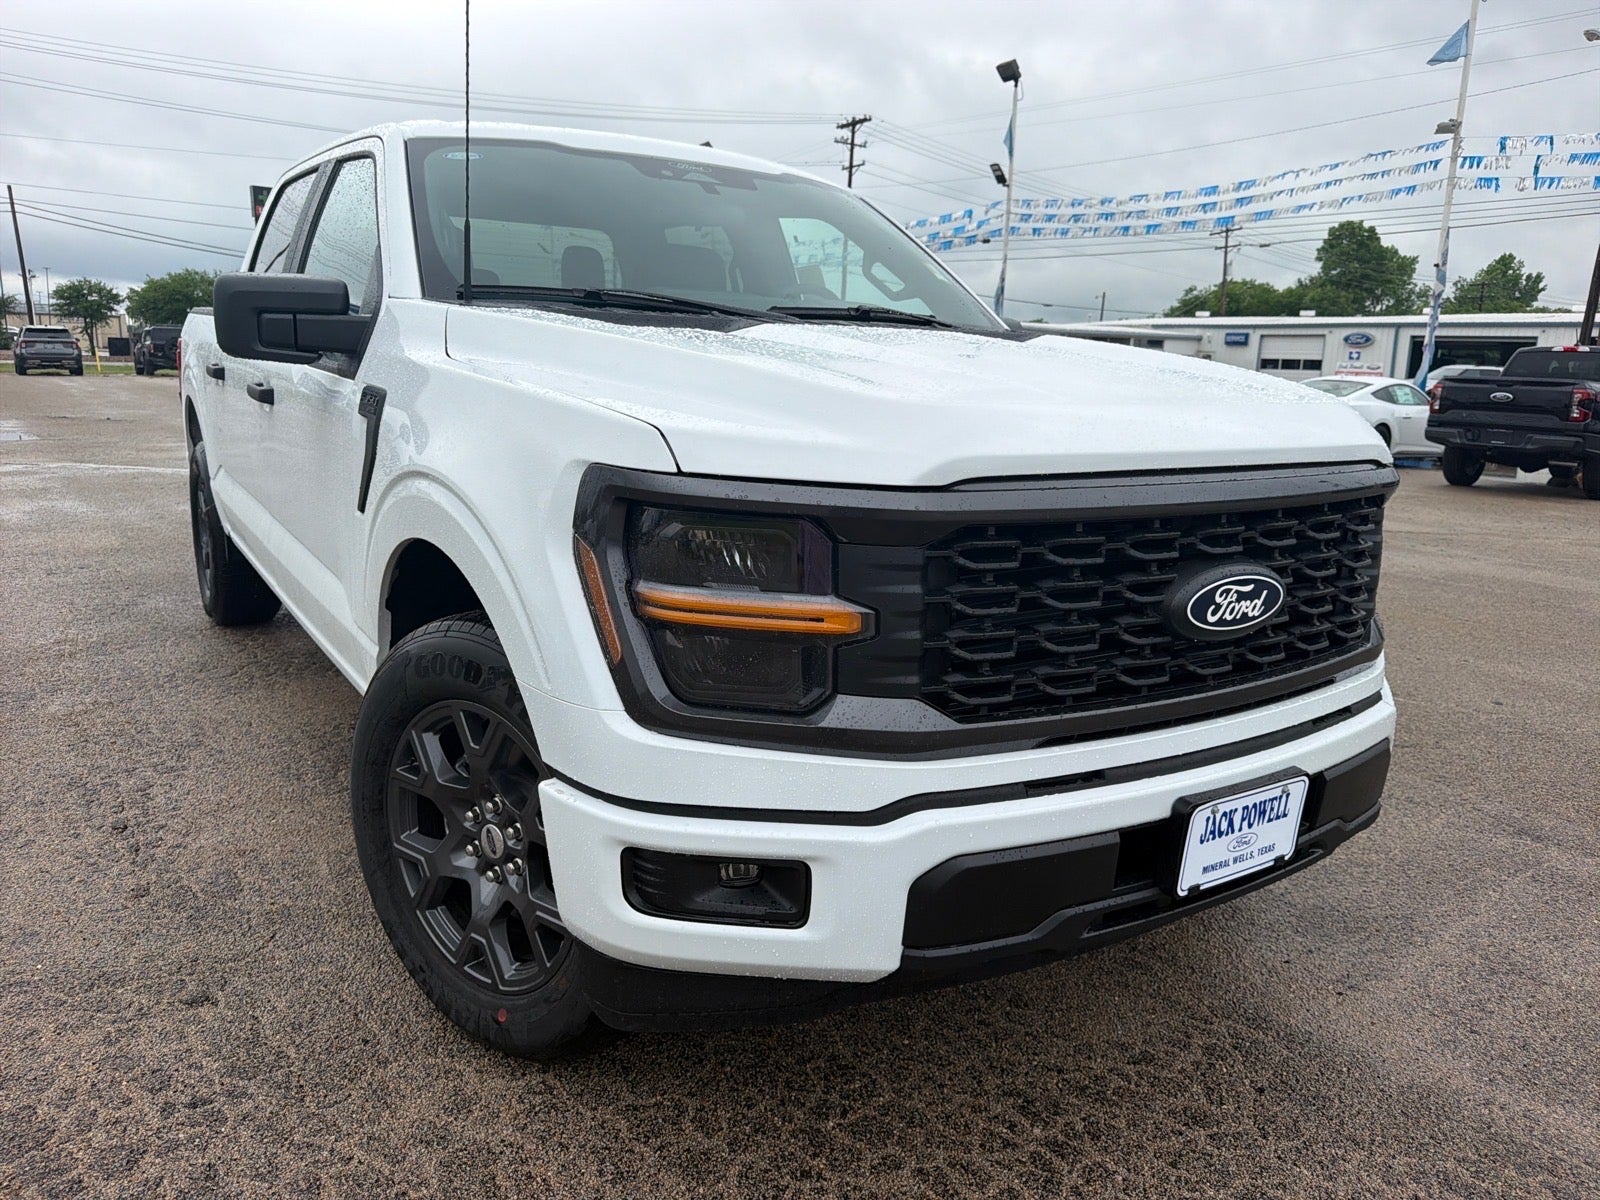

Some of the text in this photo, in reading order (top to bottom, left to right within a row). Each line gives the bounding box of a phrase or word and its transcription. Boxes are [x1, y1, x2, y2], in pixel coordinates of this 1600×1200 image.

[1206, 583, 1268, 623] Ford
[1200, 792, 1291, 845] JACK POWELL
[1202, 843, 1276, 875] MINERAL WELLS, TEXAS
[1232, 835, 1253, 850] Ford
